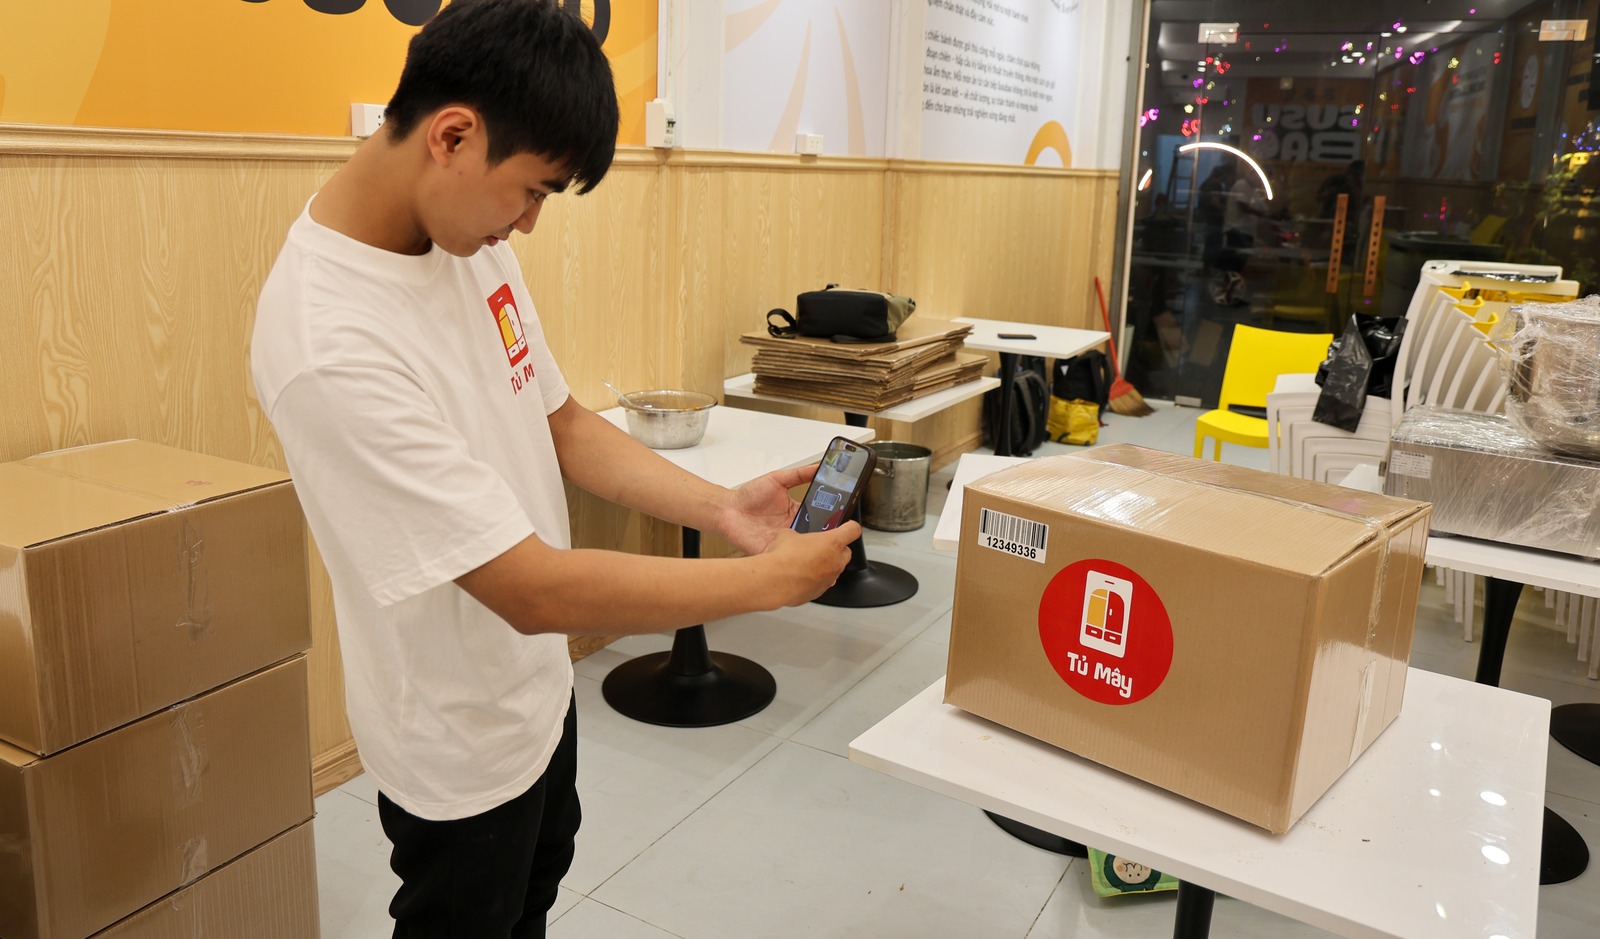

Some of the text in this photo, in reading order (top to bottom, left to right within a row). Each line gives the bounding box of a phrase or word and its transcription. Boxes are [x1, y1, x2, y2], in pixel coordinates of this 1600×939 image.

[941, 32, 951, 45] bánh
[987, 536, 1036, 559] 12349336
[1067, 651, 1132, 699] Tủ Mây
